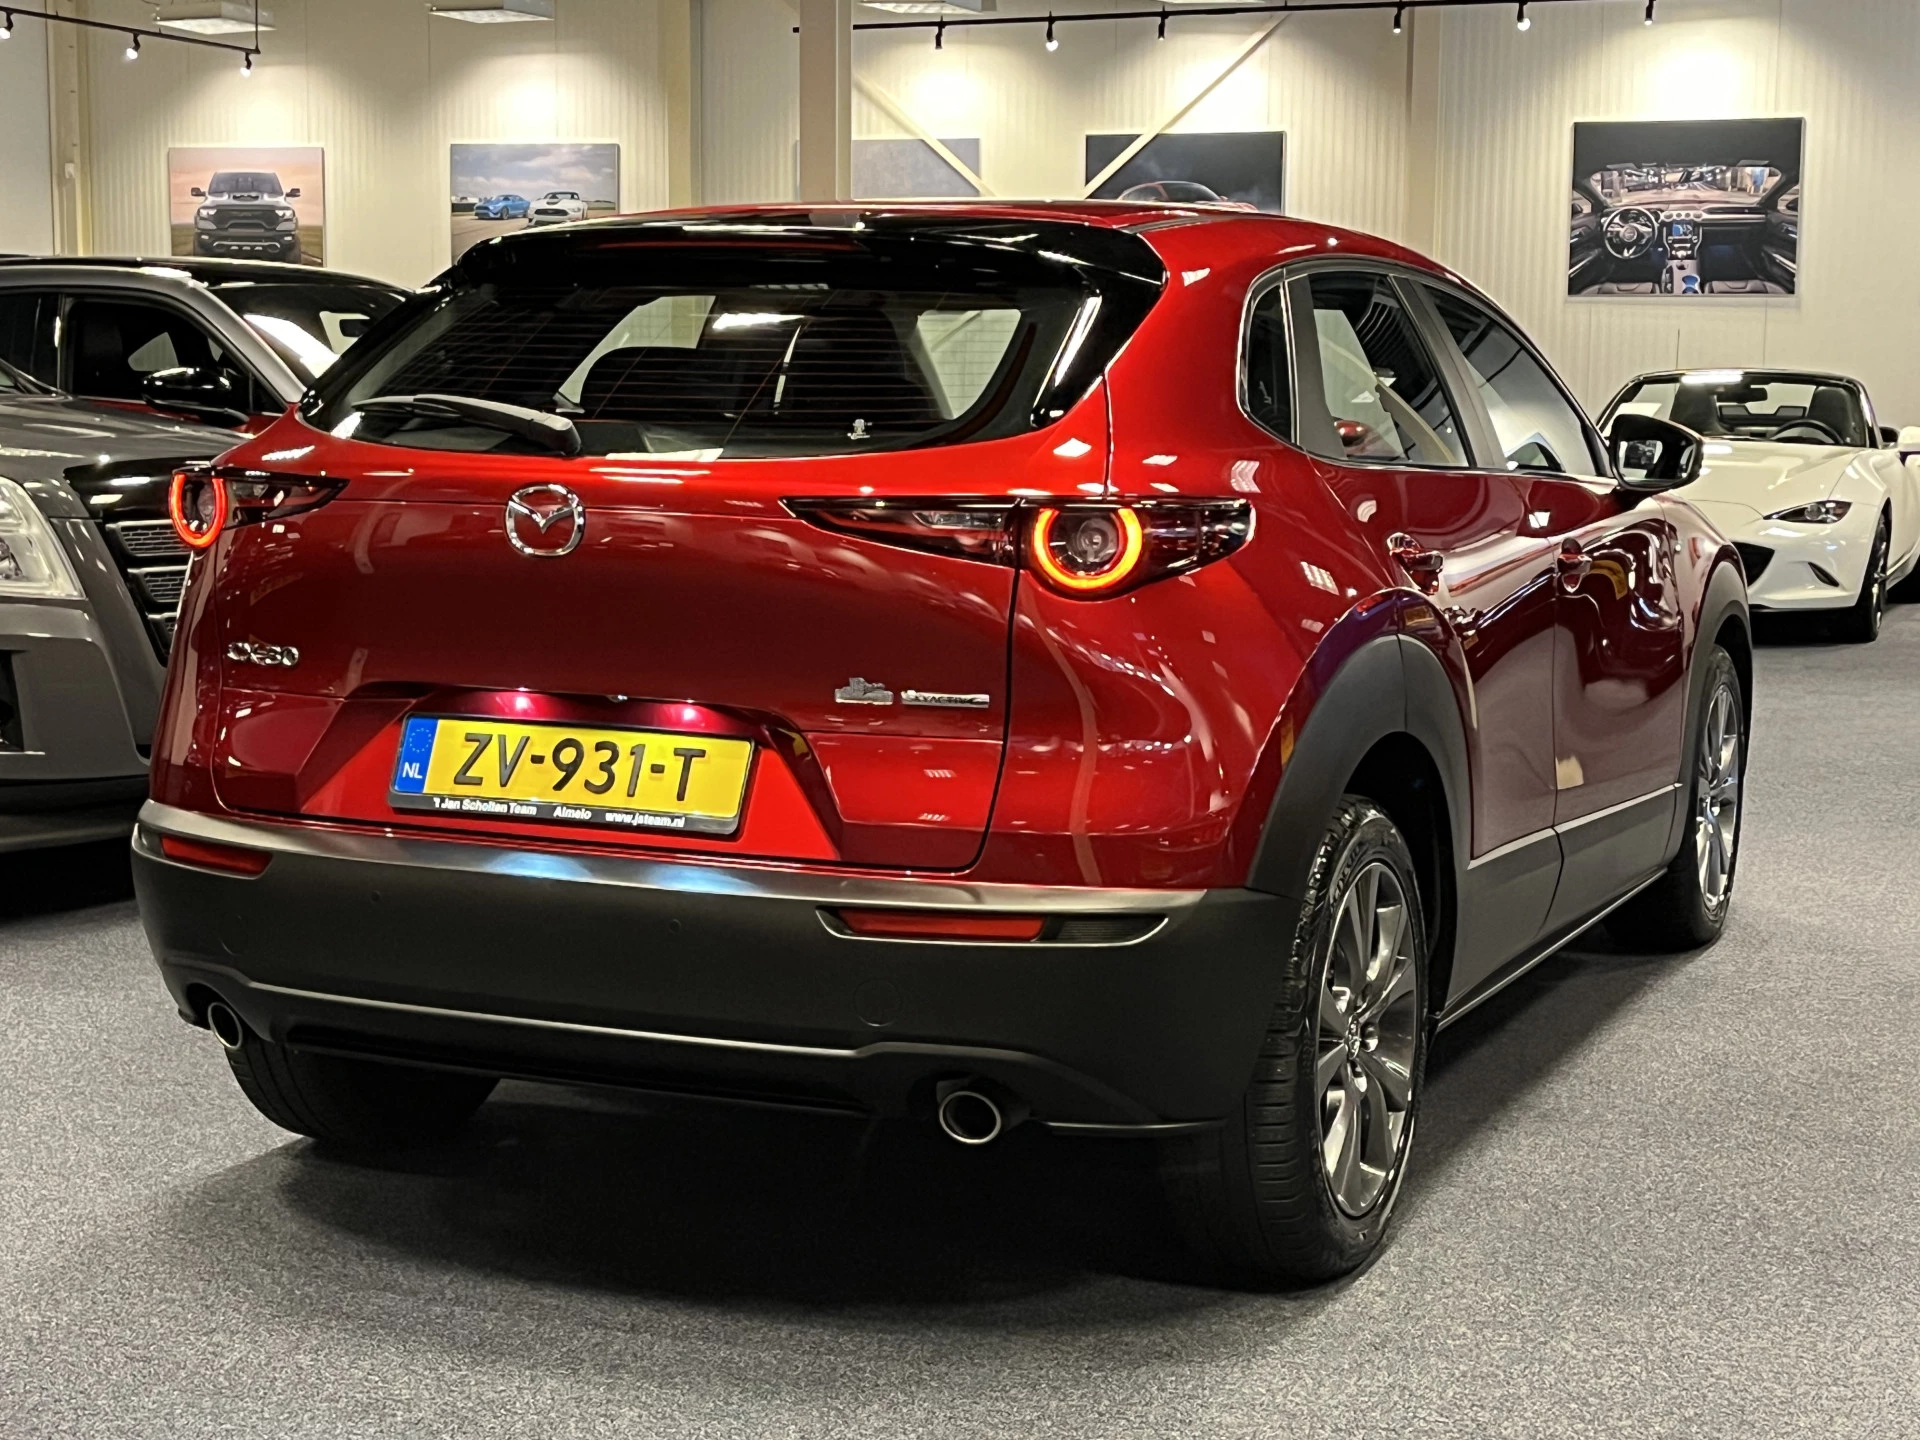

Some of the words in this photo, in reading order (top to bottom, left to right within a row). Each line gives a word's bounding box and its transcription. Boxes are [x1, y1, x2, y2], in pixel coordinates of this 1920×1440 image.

[402, 761, 423, 780] NL
[453, 732, 706, 802] ZV-931-T
[441, 798, 461, 810] Jan
[462, 799, 508, 813] Scholten
[509, 802, 538, 816] Team
[553, 806, 592, 820] Almelo
